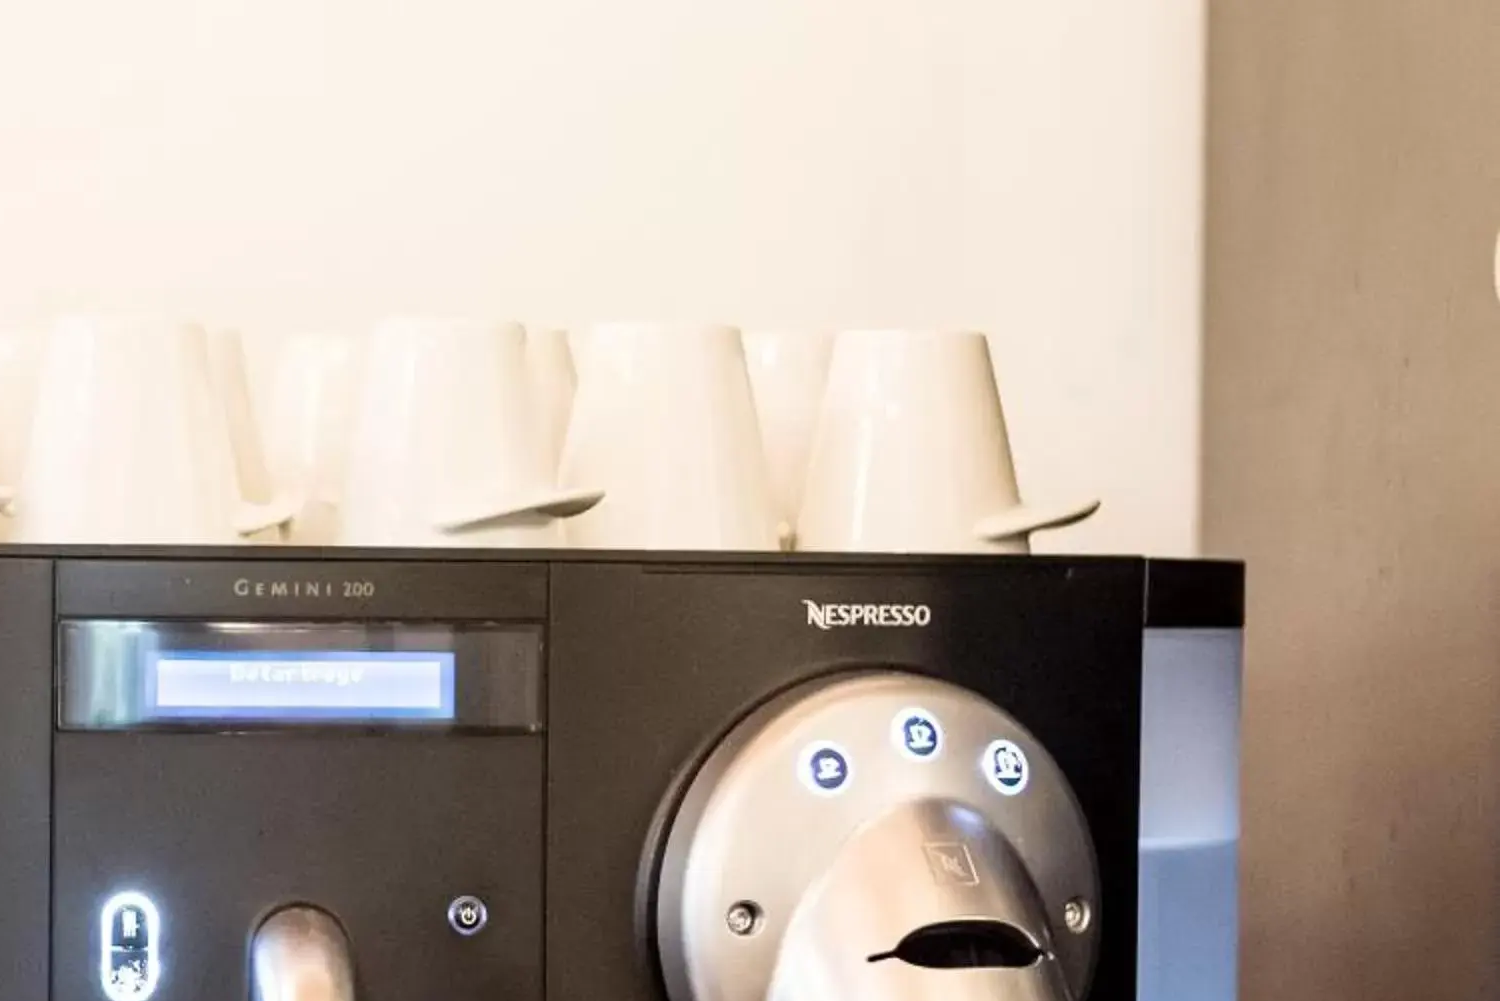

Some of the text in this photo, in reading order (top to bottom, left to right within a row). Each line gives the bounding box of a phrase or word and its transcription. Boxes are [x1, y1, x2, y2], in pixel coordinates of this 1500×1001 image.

[234, 578, 375, 597] GEMINI 200
[802, 600, 931, 629] NESPRESSO
